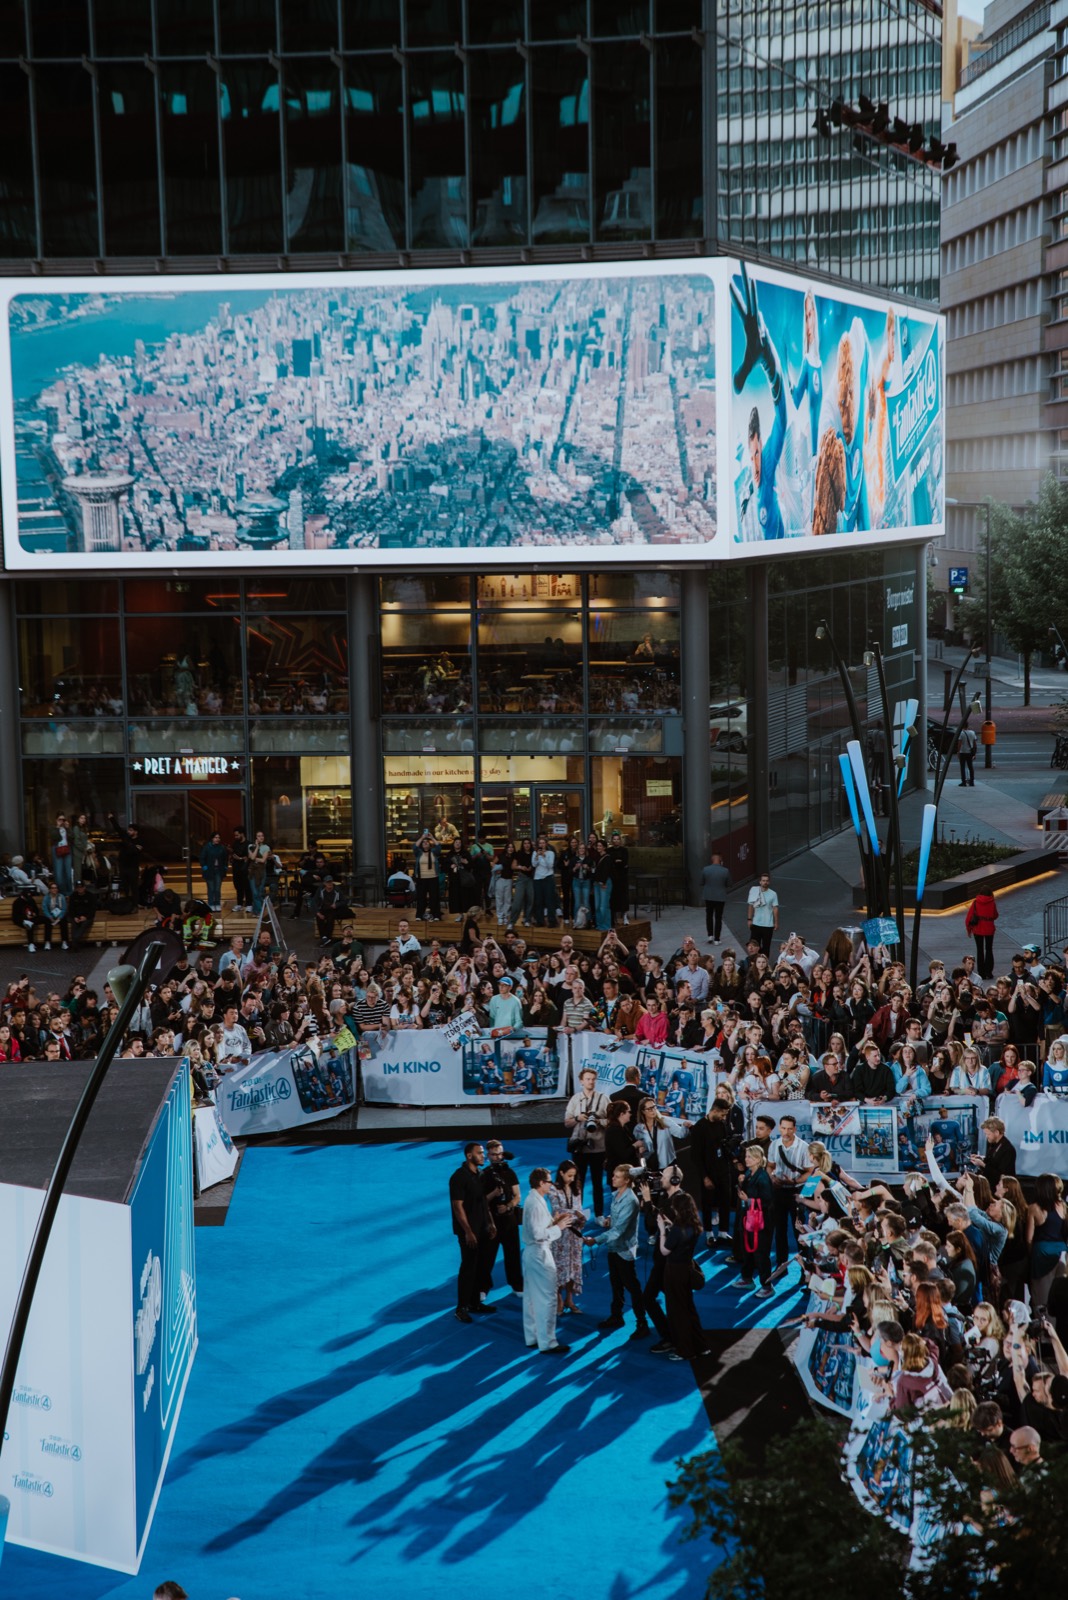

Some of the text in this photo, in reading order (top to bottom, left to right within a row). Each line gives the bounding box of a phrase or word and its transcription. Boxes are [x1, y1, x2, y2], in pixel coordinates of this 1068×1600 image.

[951, 570, 958, 580] P
[144, 756, 229, 775] PRET A MANGER
[489, 768, 501, 777] day
[383, 1061, 442, 1075] IM KINO
[231, 1083, 276, 1111] Fantastic
[1024, 1130, 1068, 1144] IM KI
